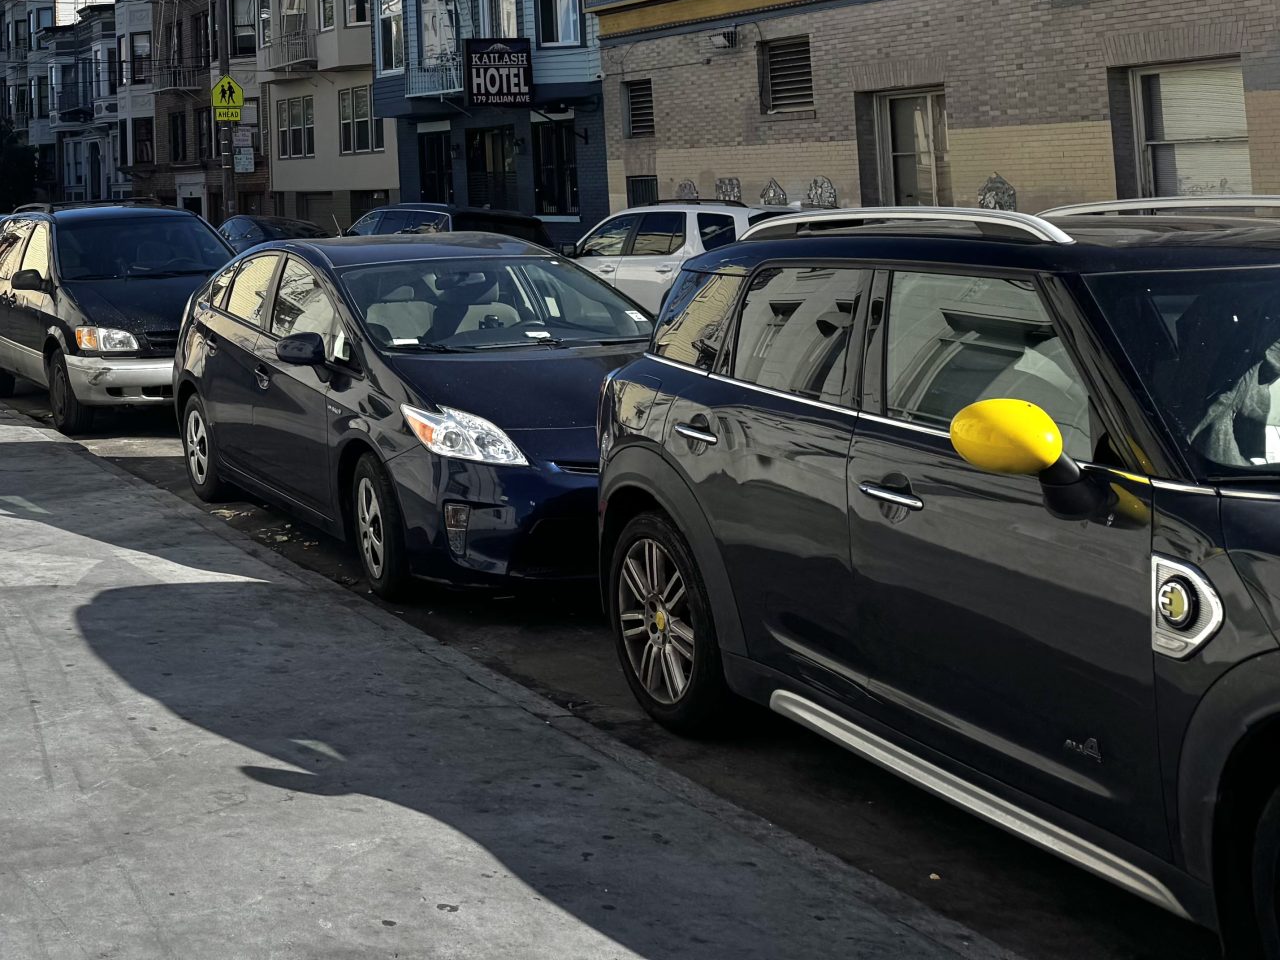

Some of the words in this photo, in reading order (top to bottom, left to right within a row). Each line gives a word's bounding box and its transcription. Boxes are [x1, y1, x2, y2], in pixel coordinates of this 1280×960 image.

[472, 53, 527, 65] KAILASH
[472, 67, 529, 94] HOTEL
[473, 95, 486, 103] 179
[488, 95, 514, 103] JULIAN
[516, 95, 530, 103] AVE
